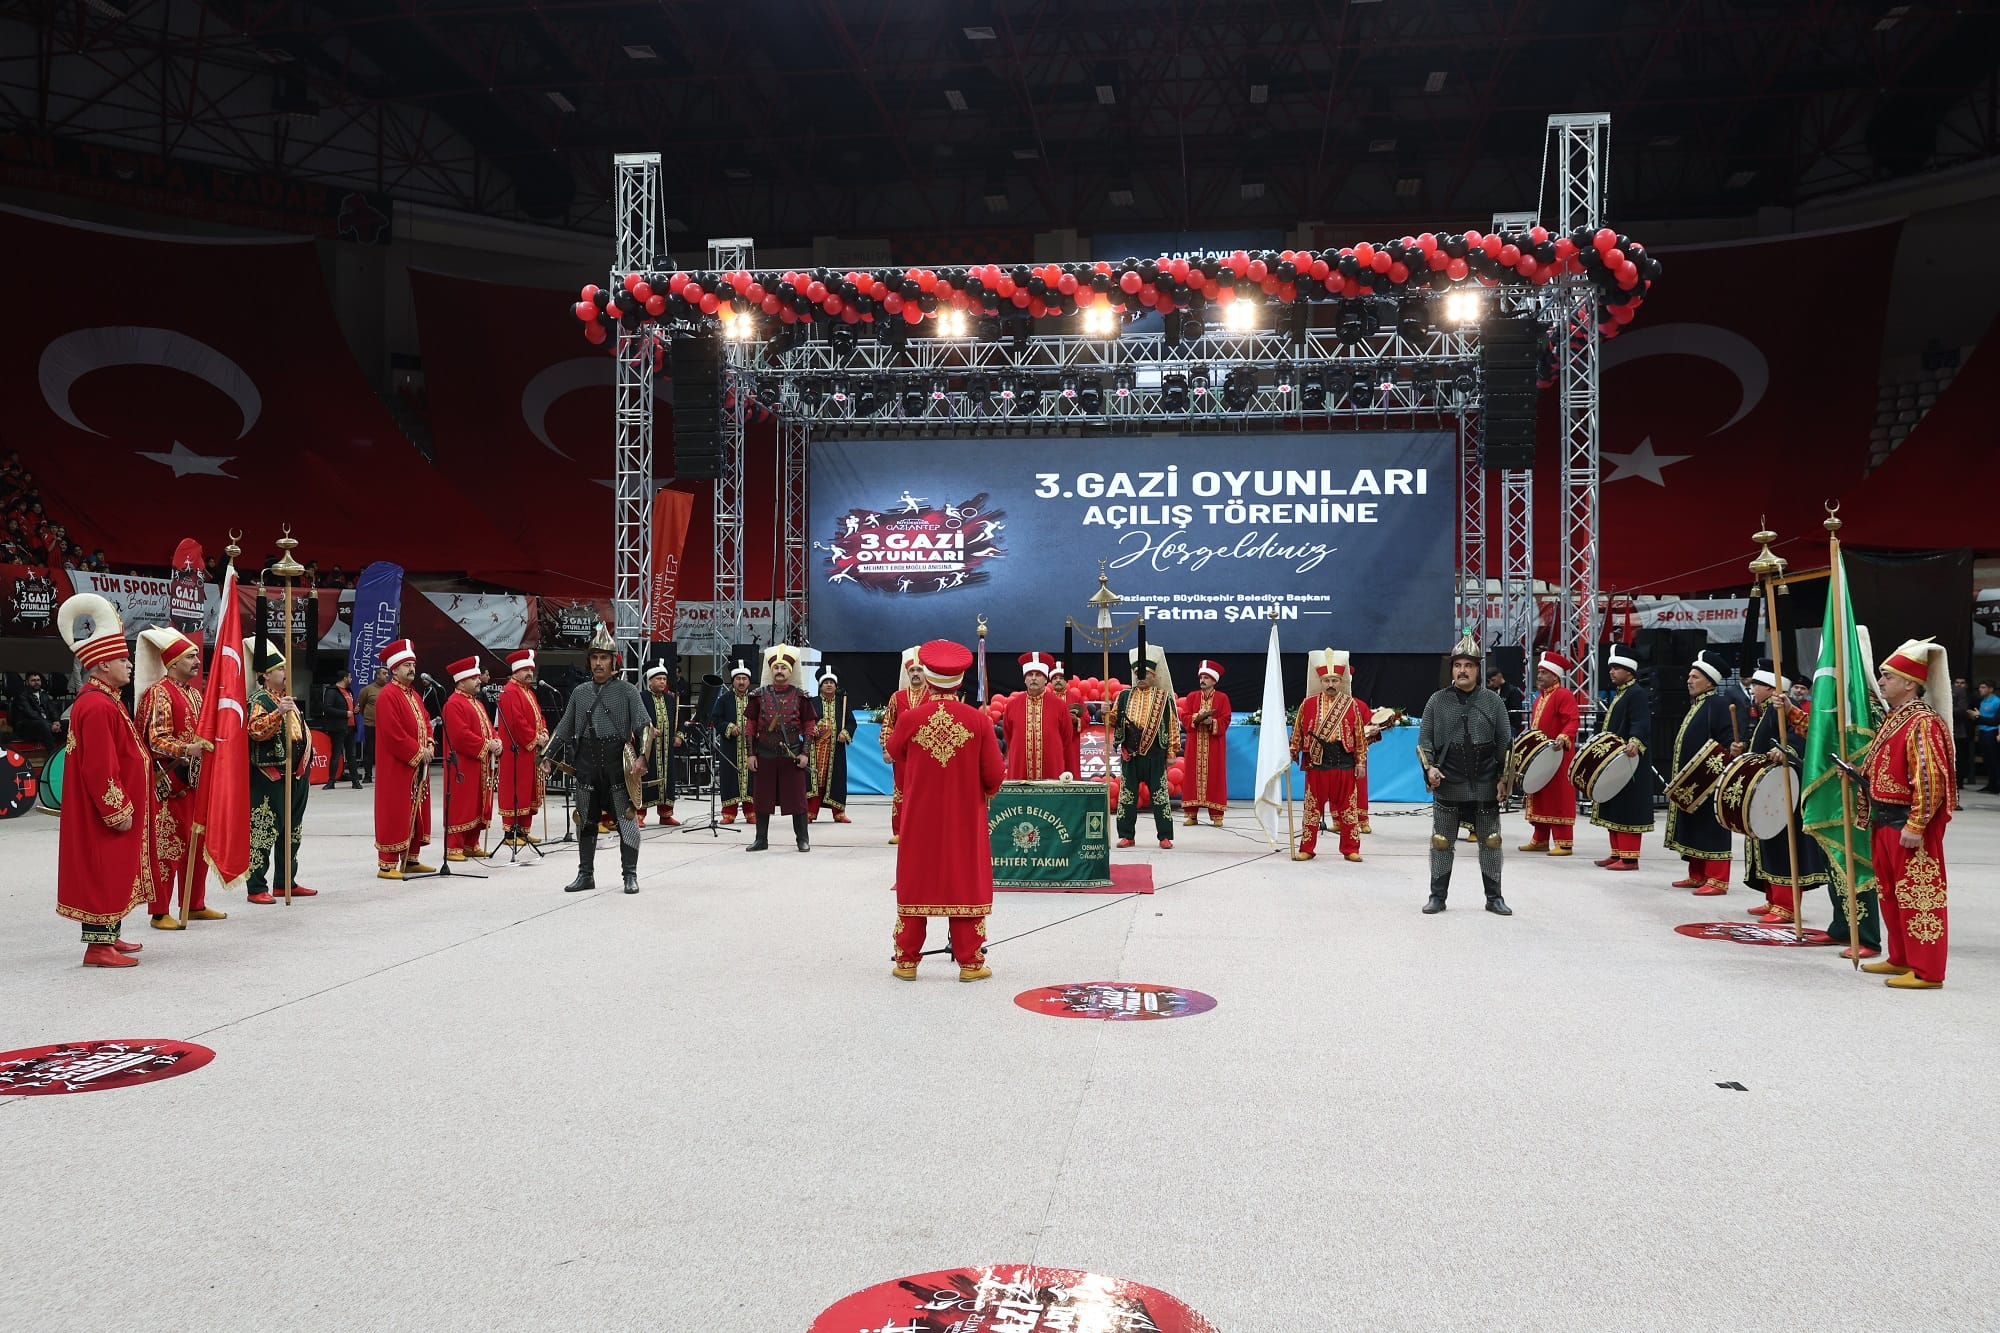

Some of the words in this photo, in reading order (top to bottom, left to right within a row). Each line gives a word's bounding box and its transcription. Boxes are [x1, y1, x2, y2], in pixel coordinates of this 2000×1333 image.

[1035, 464, 1179, 498] 3.GAZİ
[1192, 468, 1428, 497] OYUNLARI
[1082, 503, 1193, 529] AÇILIŞ
[1202, 497, 1378, 525] TÖRENİNE
[860, 530, 965, 549] 3.GAZİ
[856, 551, 965, 562] OYUNLARI
[1109, 529, 1338, 574] Hoşgeldiniz
[90, 574, 121, 592] TÜM
[176, 586, 199, 602] GAZİ
[1173, 594, 1234, 603] Büyükşehir
[1237, 594, 1284, 603] Belediye
[1286, 594, 1331, 603] Başkanı
[171, 598, 204, 610] OYUNLARI
[1144, 605, 1218, 620] Fatma
[1224, 602, 1298, 623] ŞAHİN
[1976, 607, 1990, 615] 26
[1657, 610, 1694, 622] SPOR
[1697, 608, 1738, 622] ŞEHRİ
[359, 621, 375, 685] BÜYÜKŞEHİR
[1026, 806, 1073, 843] BELEDİYESİ
[1031, 858, 1069, 867] TAKIMI
